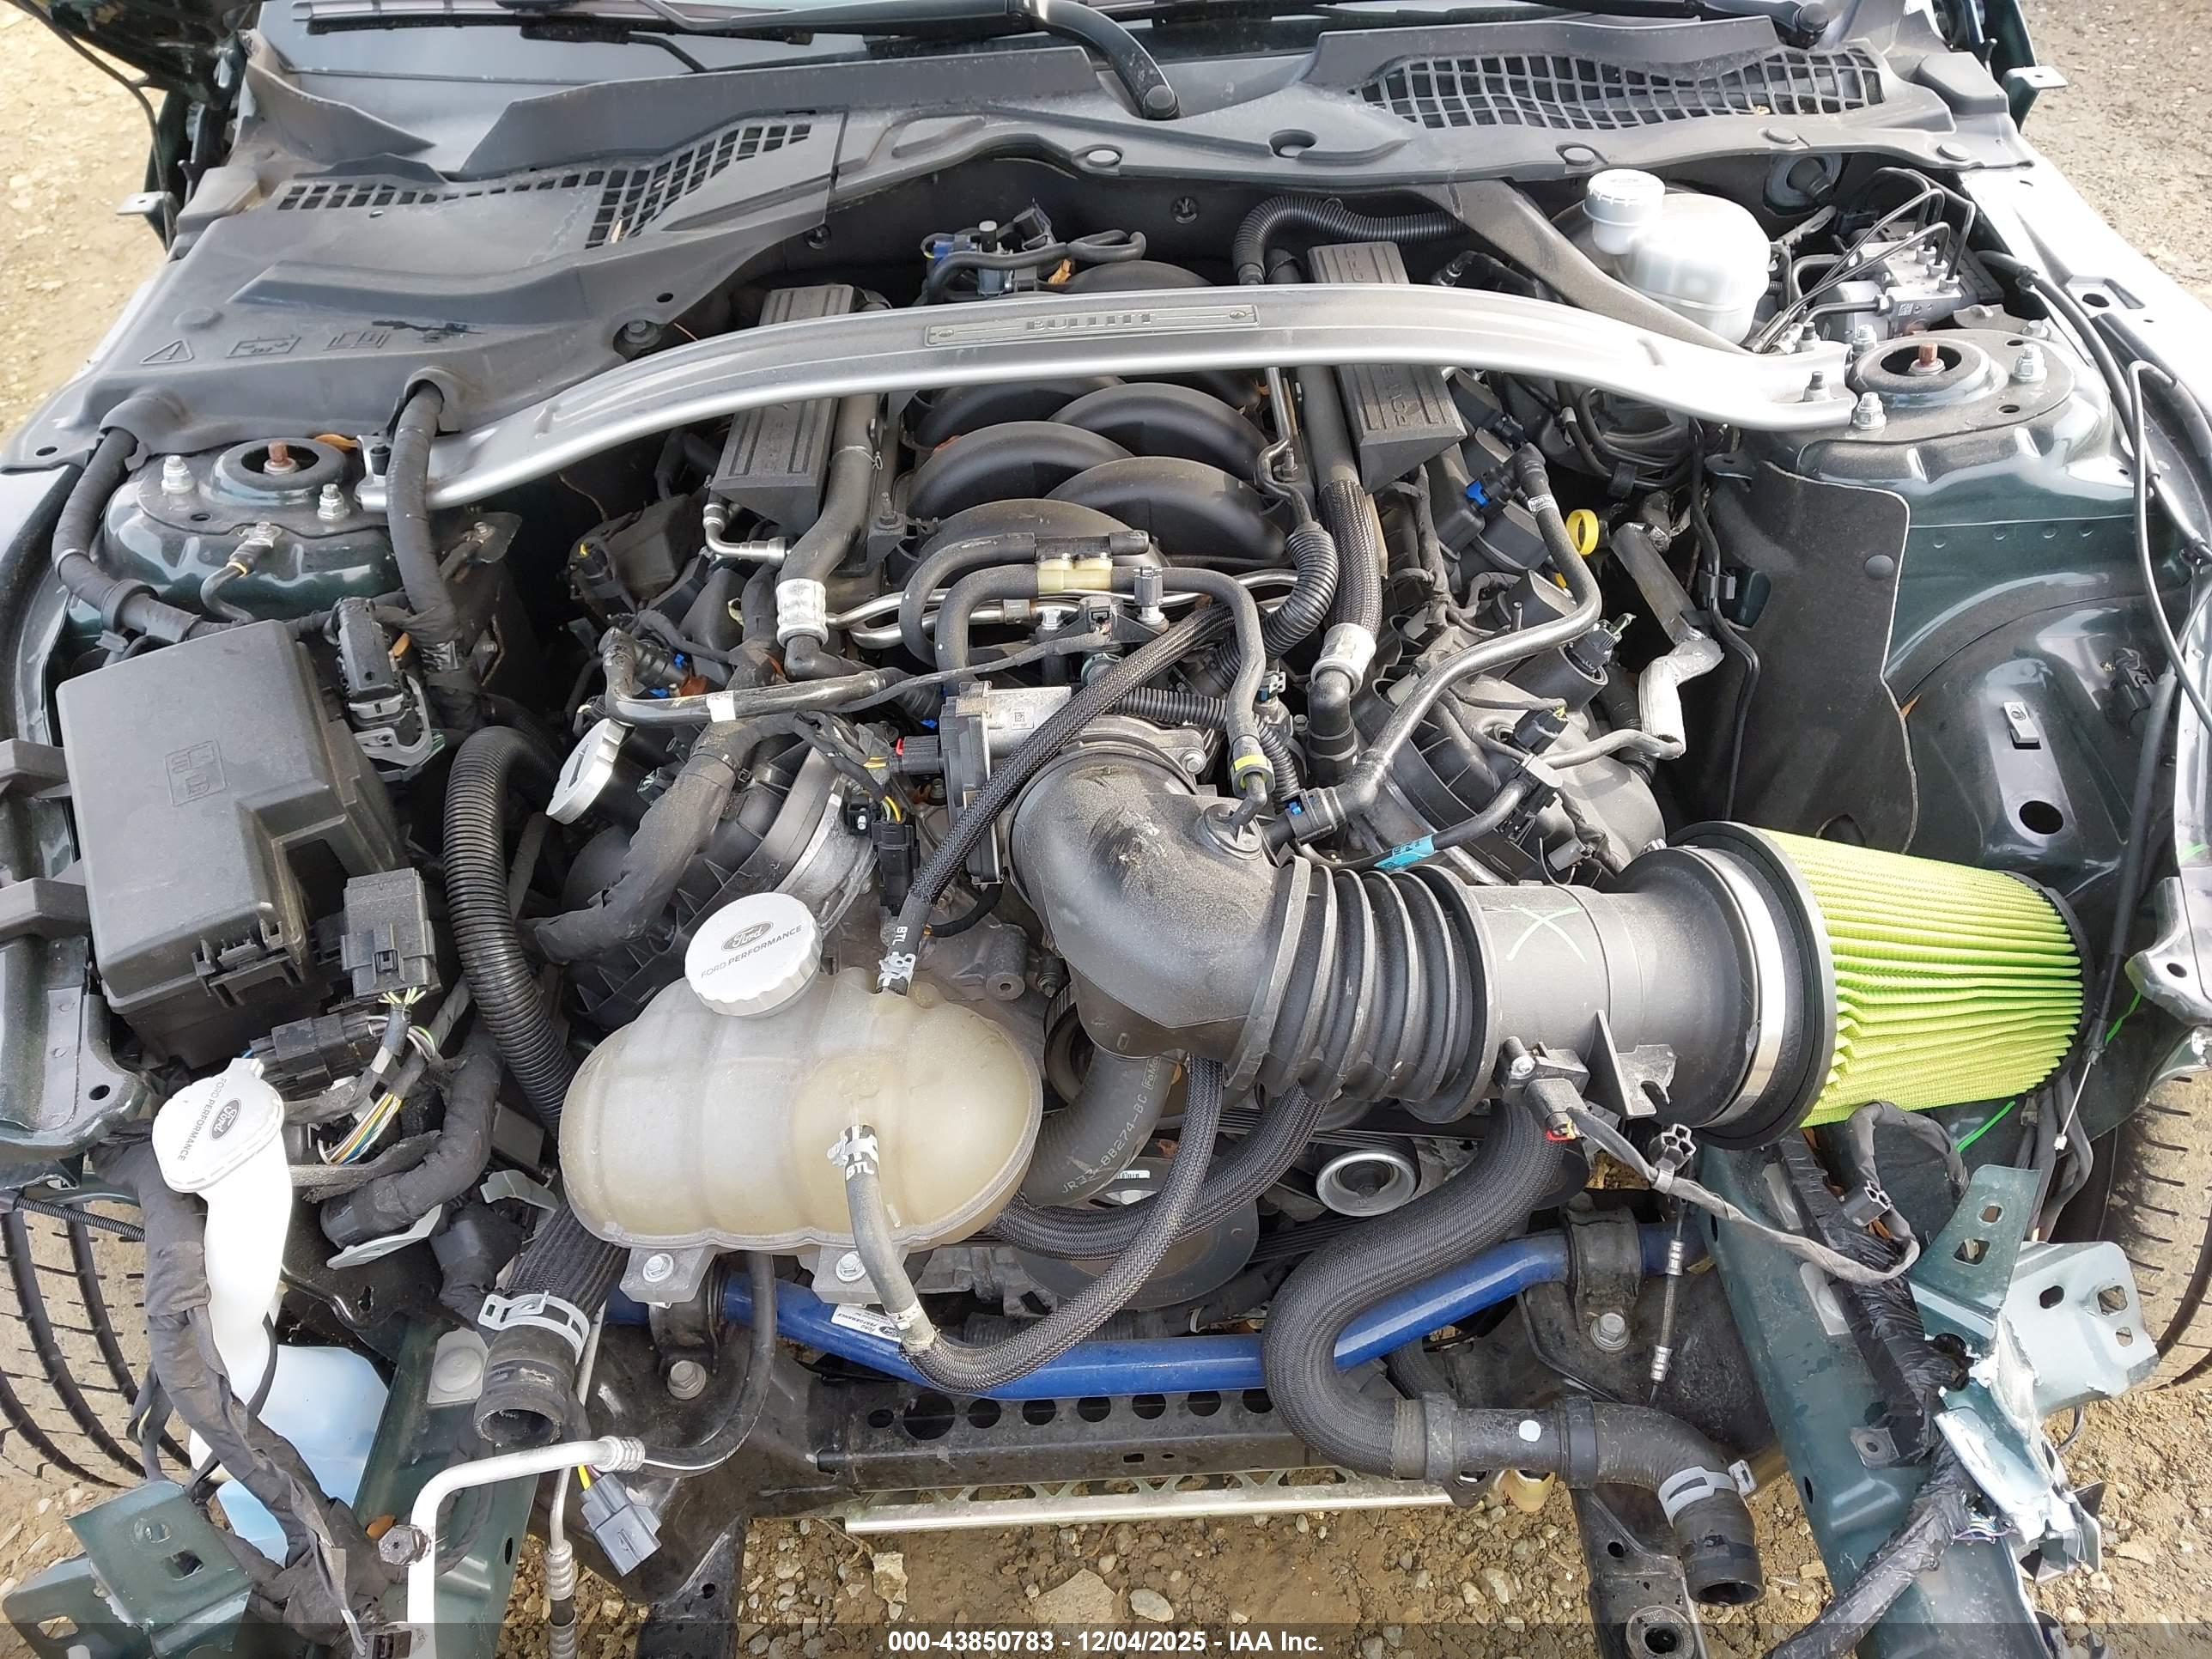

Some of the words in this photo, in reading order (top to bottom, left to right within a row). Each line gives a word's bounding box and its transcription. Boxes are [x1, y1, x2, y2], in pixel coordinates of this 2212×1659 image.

[1026, 311, 1156, 331] BULLITT
[1381, 364, 1408, 427] POWE
[892, 926, 908, 946] BTL
[701, 962, 727, 979] FORD
[728, 925, 804, 966] PERFORMANCE
[1144, 1056, 1159, 1089] FoMo
[210, 1077, 228, 1099] FORD
[178, 1098, 216, 1162] PERFORMANCE
[846, 1161, 875, 1181] BTL
